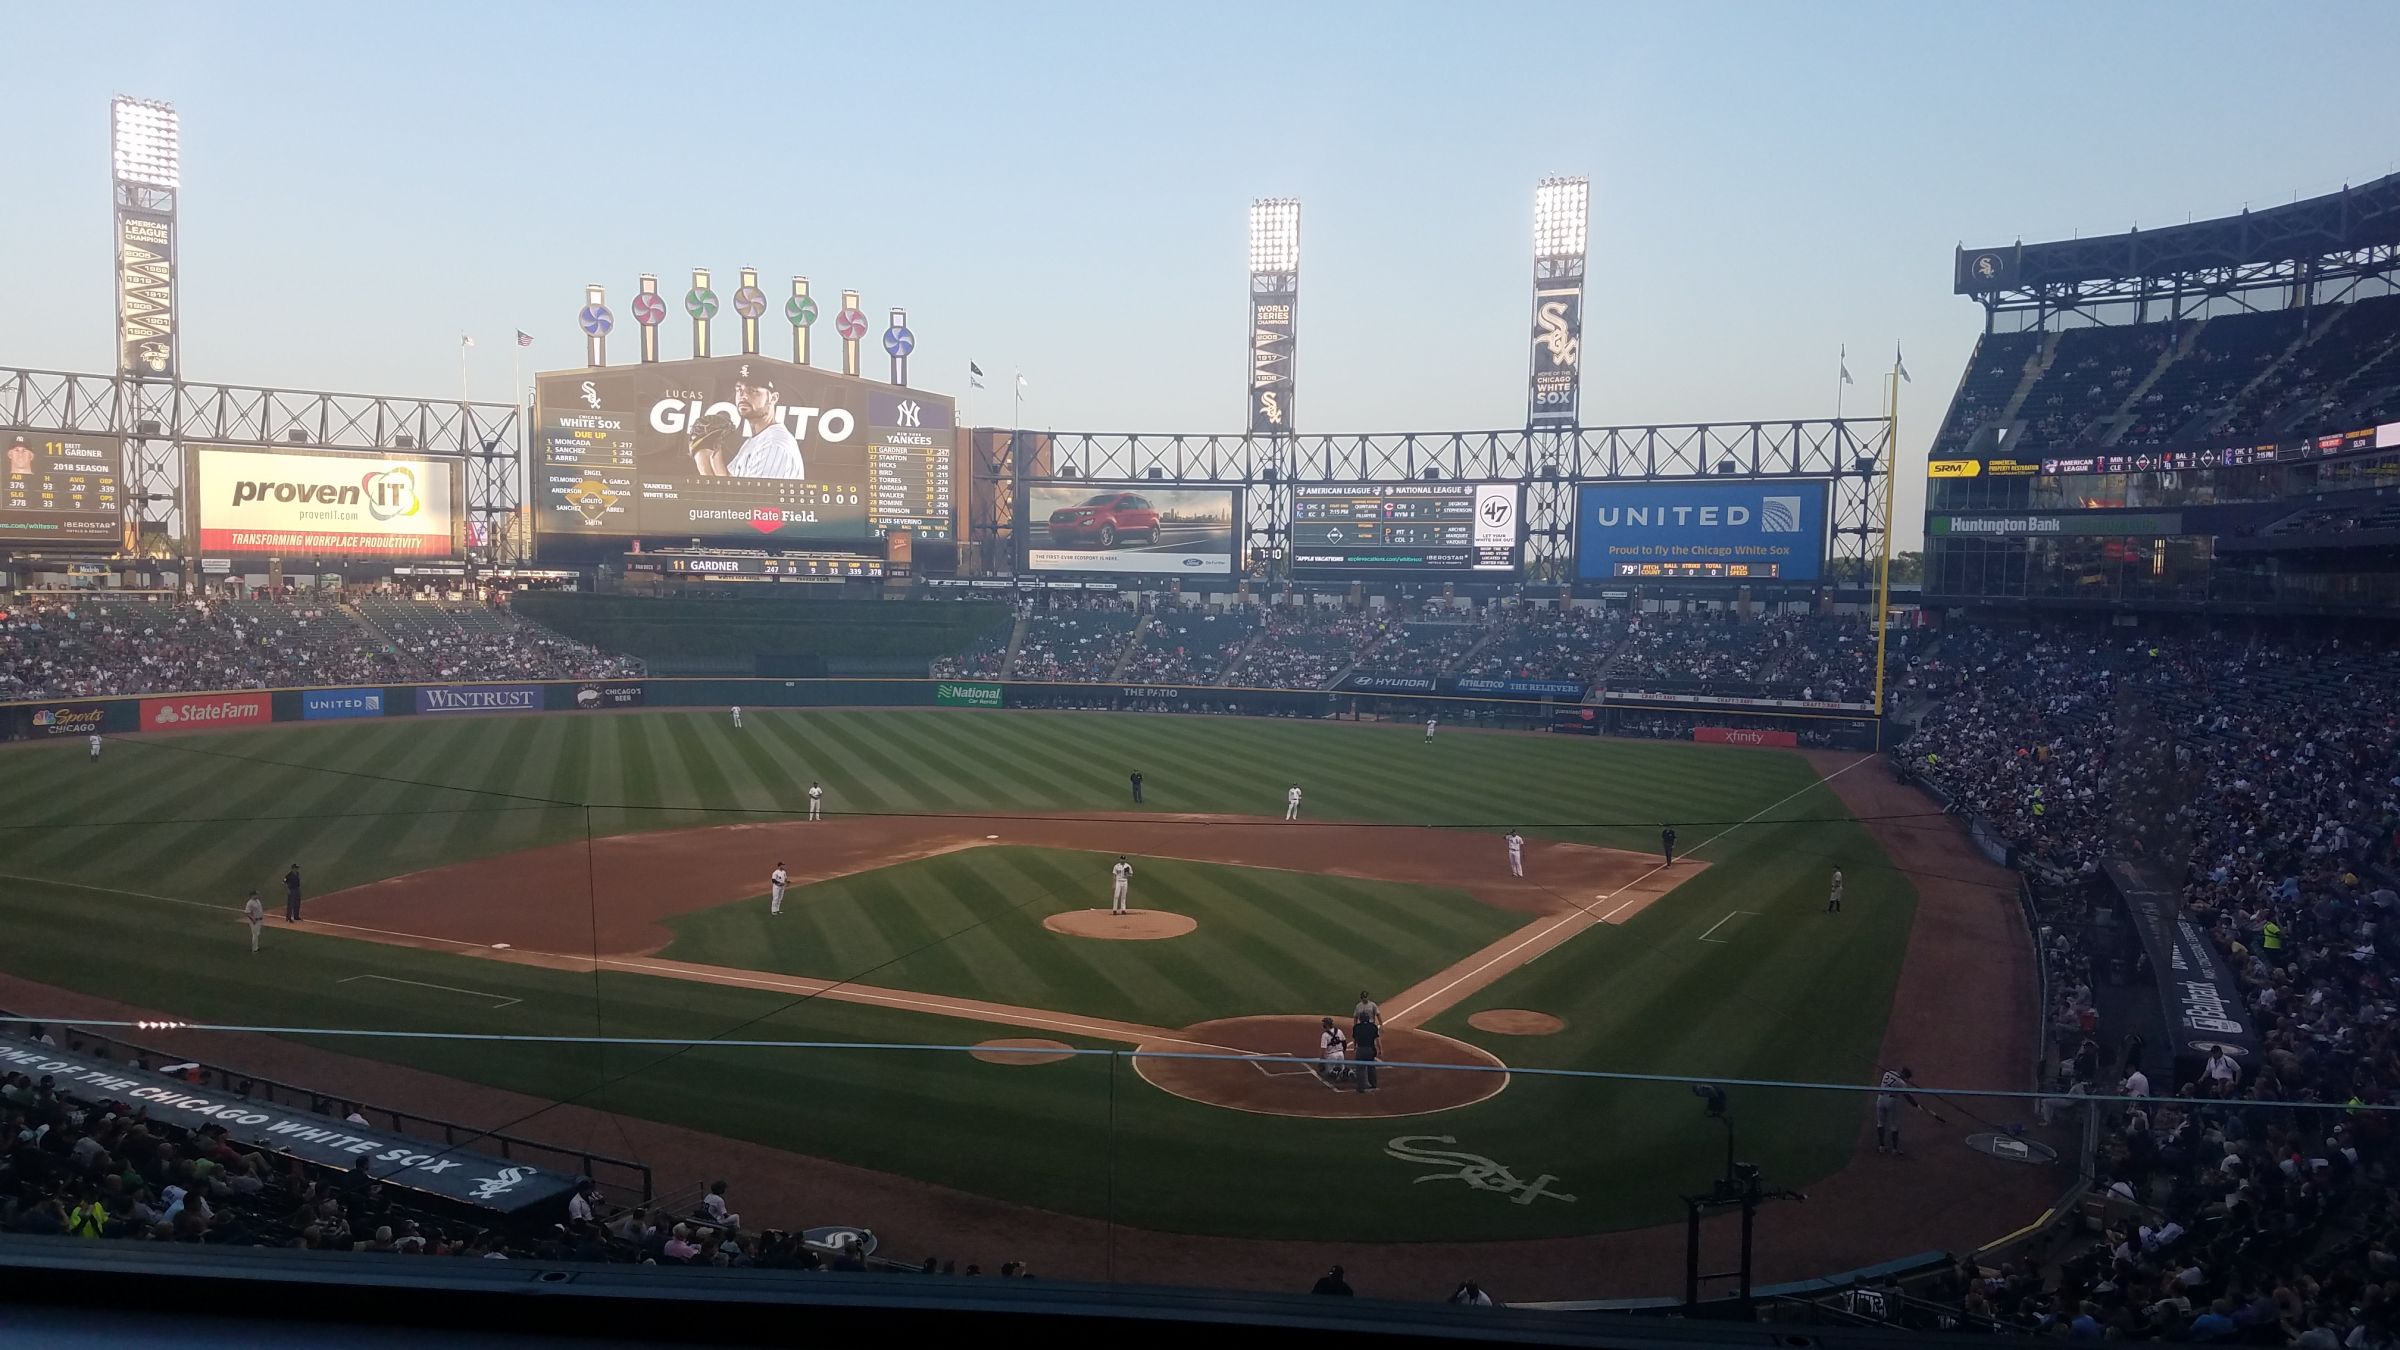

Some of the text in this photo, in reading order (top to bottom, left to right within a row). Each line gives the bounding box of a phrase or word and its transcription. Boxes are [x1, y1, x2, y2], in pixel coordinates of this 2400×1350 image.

[125, 219, 168, 230] AMERICAN
[125, 226, 168, 238] LEAGUE
[125, 235, 168, 246] CHAMPIONS
[1257, 312, 1289, 320] SERIES
[1537, 376, 1571, 384] CHICAGO
[1537, 383, 1571, 392] WHITE
[665, 390, 704, 399] LUCAS
[1536, 391, 1571, 405] SOX
[560, 418, 621, 430] WHITE SOX
[554, 438, 591, 446] MONCADA
[886, 435, 932, 445] YANKEES
[45, 442, 62, 456] 11
[65, 449, 102, 458] GARDNER
[554, 446, 586, 454] SANCHEZ
[53, 463, 109, 473] 2018 SEASON
[1934, 464, 1962, 472] SRM
[232, 480, 405, 507] proven IT
[551, 487, 631, 497] ANDERSON MONCADA
[1306, 487, 1342, 495] AMERICAN
[822, 494, 858, 504] 0 0 0
[99, 502, 116, 510] .716
[299, 509, 359, 521] provenIT.com
[689, 508, 818, 523] guaranteed Rate Field.
[1598, 506, 1750, 527] UNITED
[1951, 517, 2027, 535] Huntington
[2028, 517, 2060, 531] Bank
[231, 533, 423, 549] TRANSFORMING WORKPLACE PRODUCTIVITY
[1260, 549, 1282, 559] 7:10
[1609, 545, 1790, 557] Proud to fly the Chicago White Sox
[673, 560, 685, 570] 11
[690, 561, 739, 571] GARDNER
[1375, 677, 1430, 688] HYUNDAI
[1458, 678, 1505, 689] ATHLETICO
[1510, 683, 1579, 693] THE RELIEVERS
[952, 685, 1000, 700] National
[1123, 687, 1178, 698] THE PATIO
[310, 699, 362, 709] UNITED
[426, 689, 534, 708] WINTRUST
[54, 708, 104, 724] Sports
[48, 723, 96, 734] CHICAGO
[1725, 730, 1764, 745] xfinity
[2177, 981, 2231, 1020] Ballpark
[1882, 1074, 1897, 1087] 27
[36, 1061, 87, 1074] OF
[75, 1071, 140, 1091] THE
[129, 1087, 269, 1125] CHICAGO
[266, 1120, 384, 1154] WHITE
[376, 1149, 463, 1174] SOX
